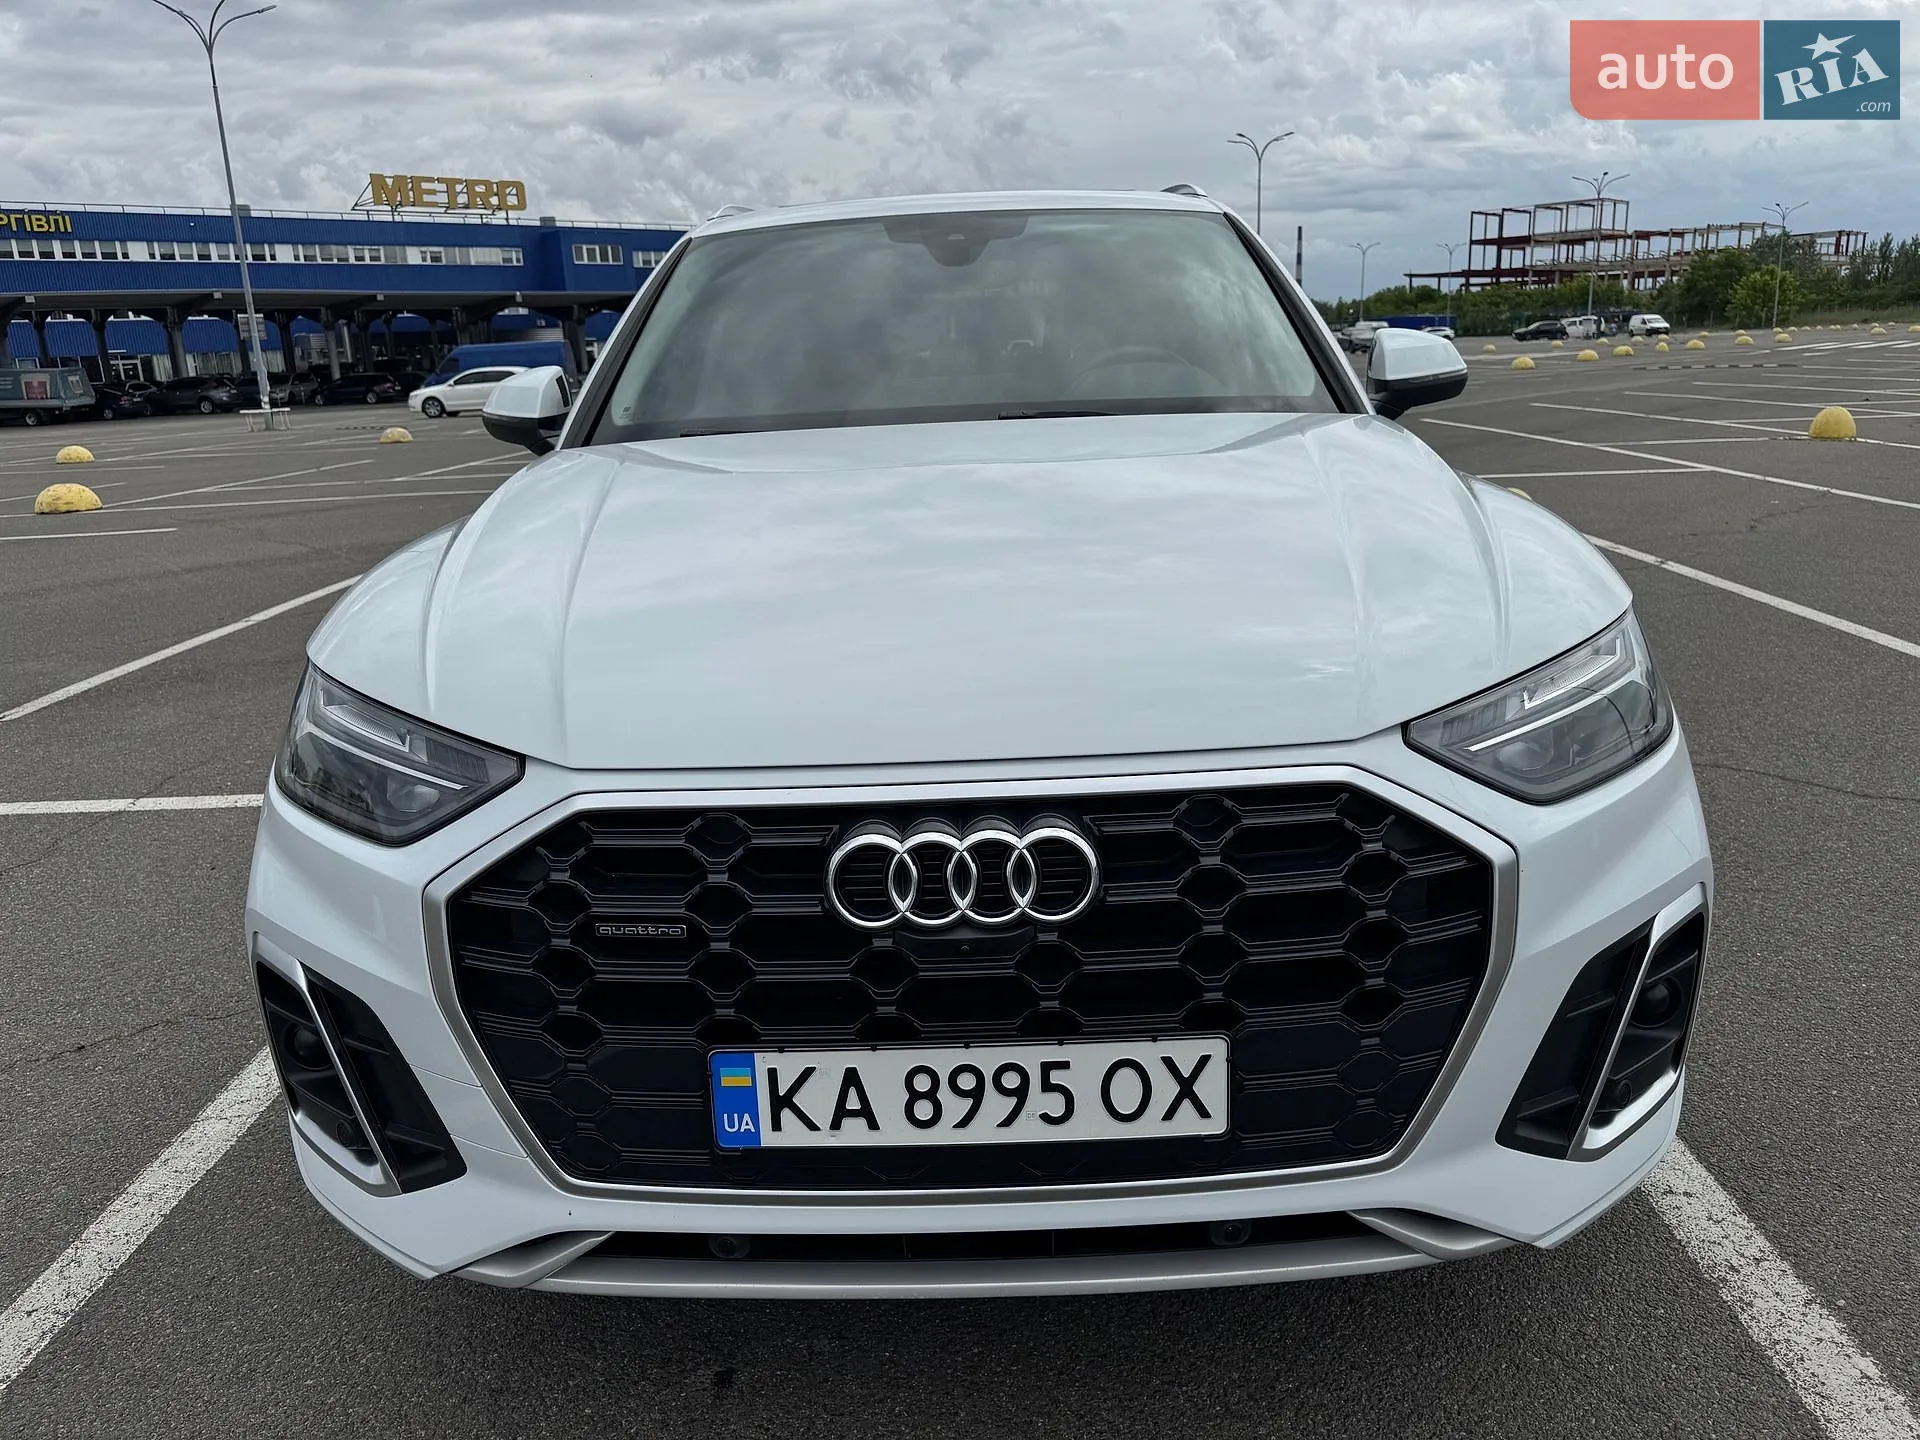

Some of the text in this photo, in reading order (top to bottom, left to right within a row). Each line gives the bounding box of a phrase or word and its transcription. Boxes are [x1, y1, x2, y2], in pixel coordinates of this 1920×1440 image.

[370, 173, 528, 211] METRO
[599, 925, 682, 936] quattro
[766, 1053, 1214, 1133] KA 8995 OX
[723, 1112, 756, 1134] UA
